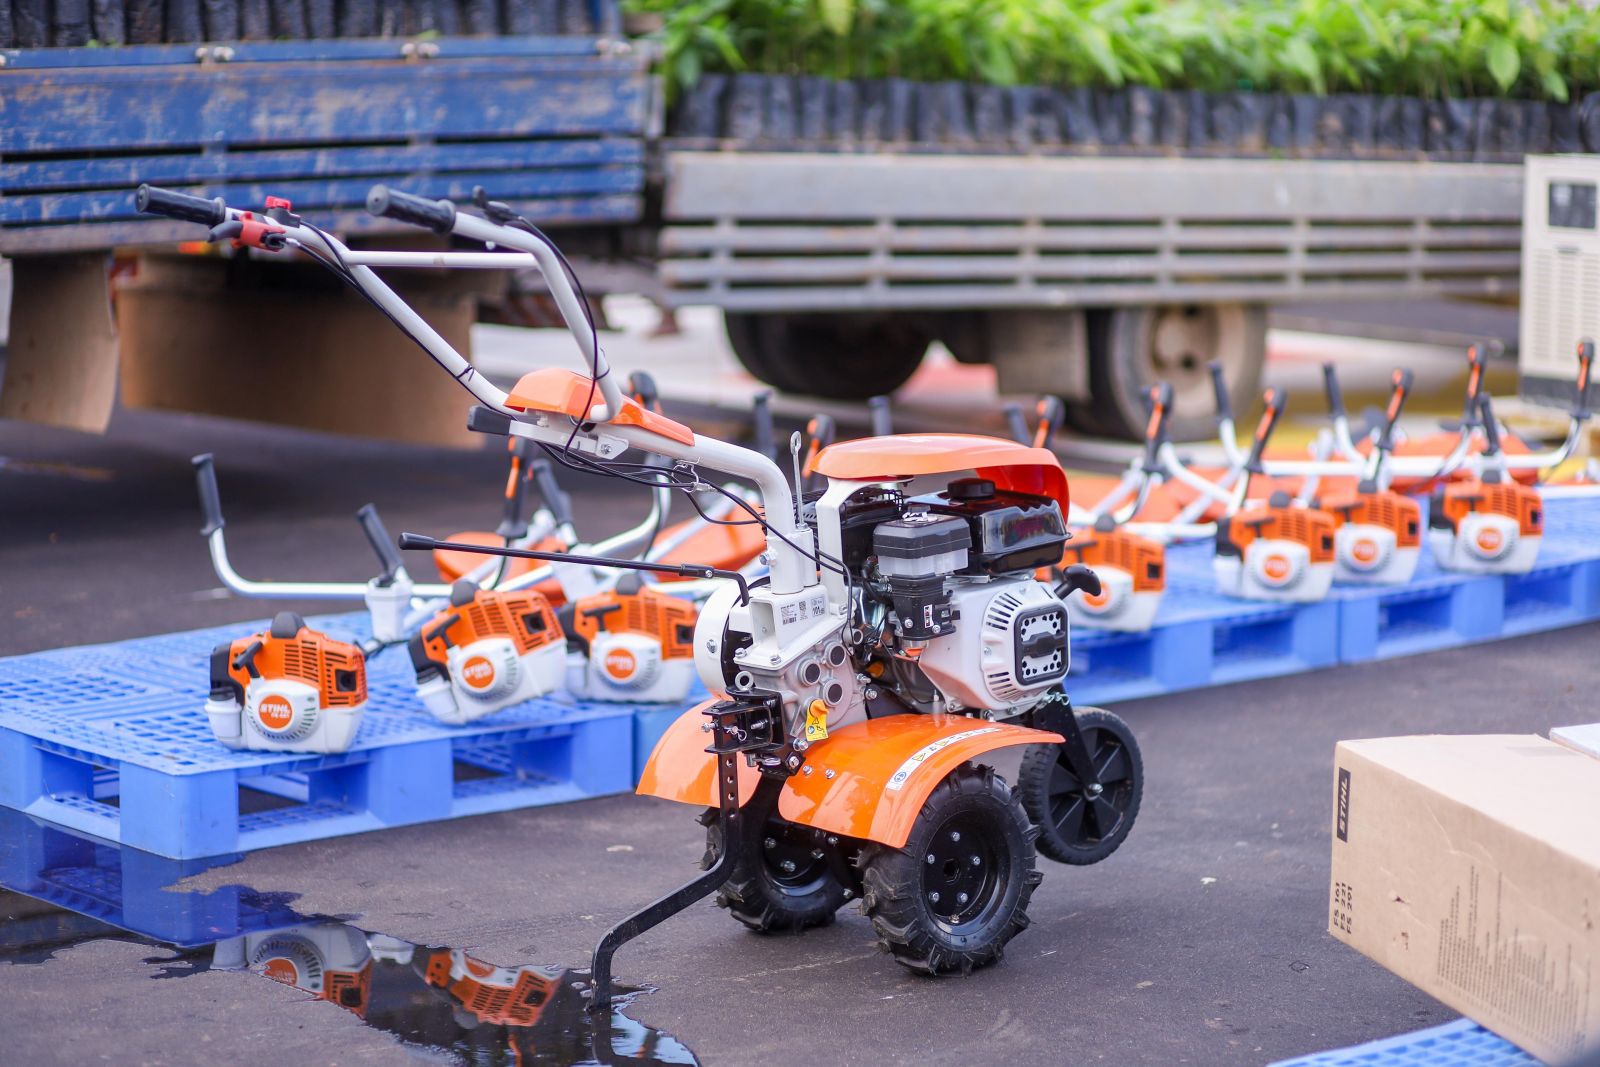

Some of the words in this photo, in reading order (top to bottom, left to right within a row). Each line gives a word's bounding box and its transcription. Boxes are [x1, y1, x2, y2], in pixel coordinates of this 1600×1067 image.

[259, 703, 288, 713] STIHL
[1334, 909, 1339, 926] FS
[1340, 913, 1346, 930] FS
[1346, 917, 1352, 934] FS
